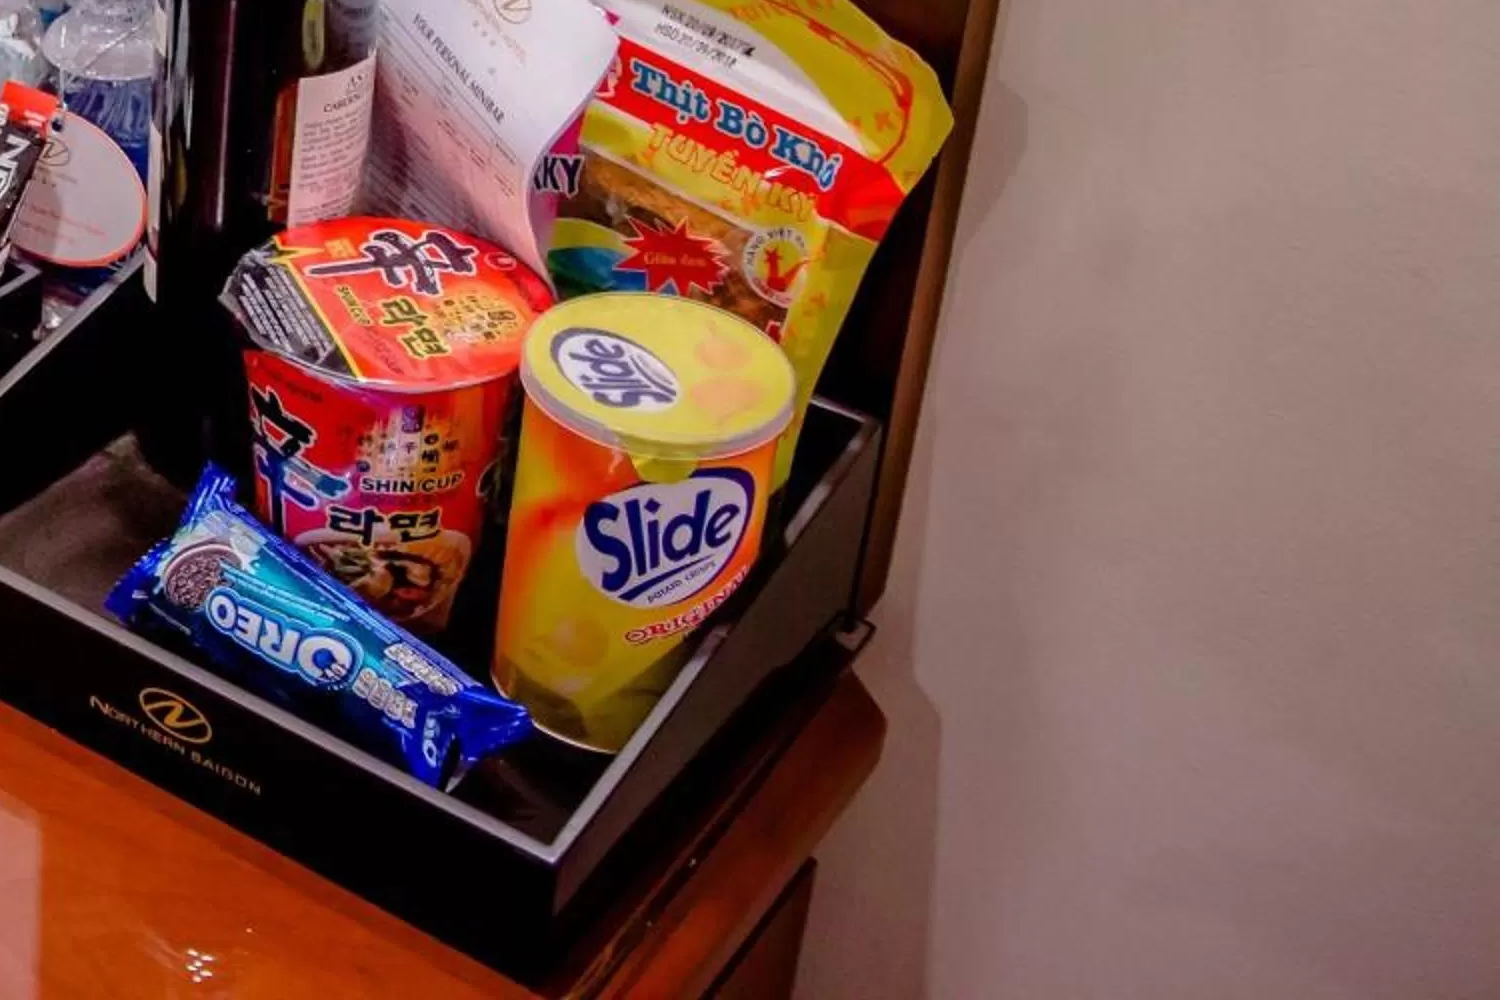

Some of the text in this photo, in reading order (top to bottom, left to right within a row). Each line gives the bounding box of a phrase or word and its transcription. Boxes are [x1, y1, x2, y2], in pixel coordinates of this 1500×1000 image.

[630, 58, 708, 125] Thịt
[715, 100, 768, 147] Bò
[533, 156, 582, 194] KY
[380, 298, 451, 358] 라면
[361, 473, 463, 493] SHIN CUP
[329, 507, 441, 546] 라면
[584, 489, 741, 593] Slide
[209, 592, 356, 684] OREO
[89, 695, 261, 796] NORTHERN SAIGON
